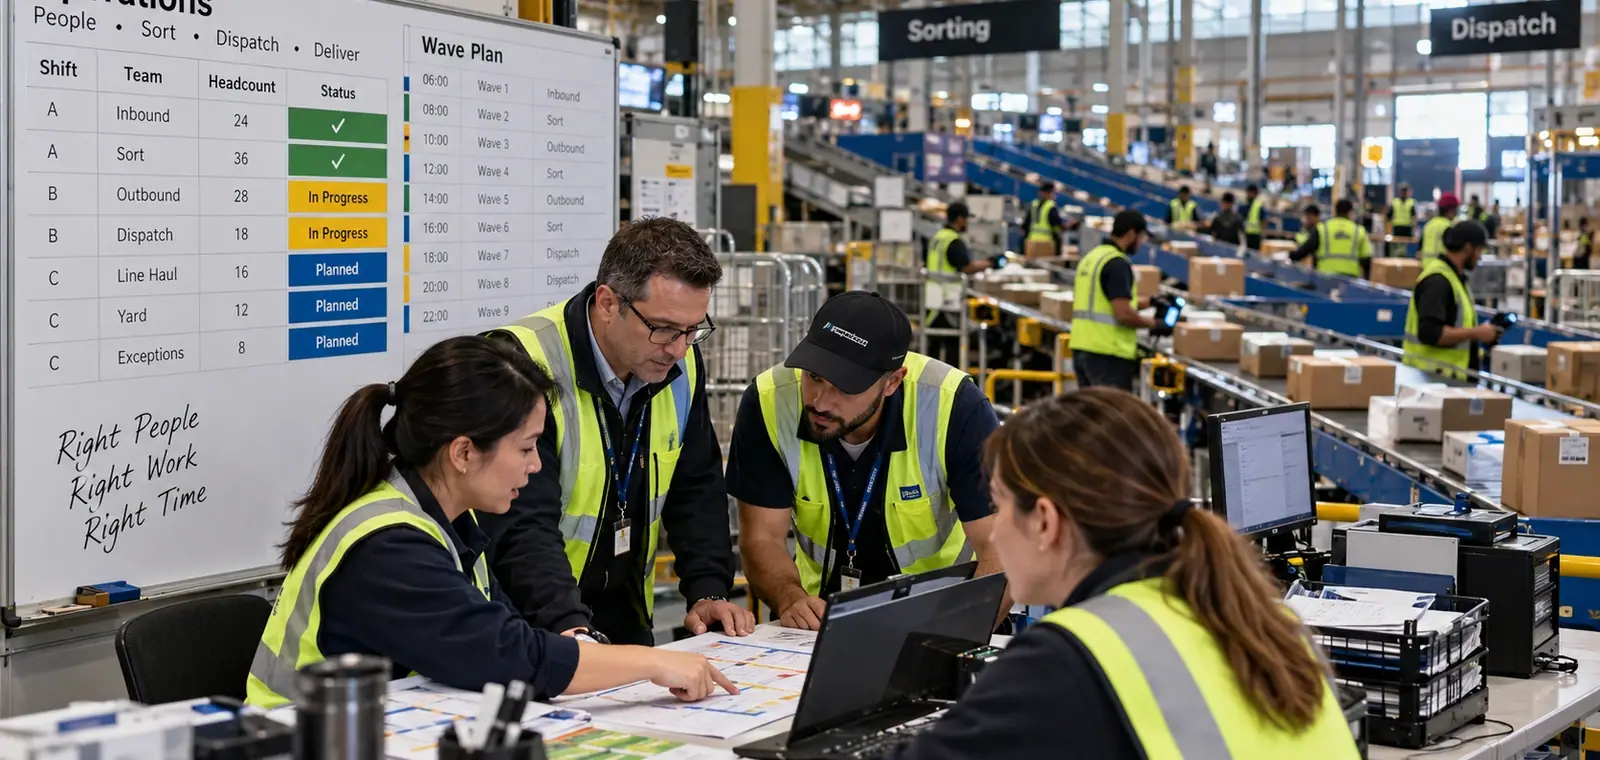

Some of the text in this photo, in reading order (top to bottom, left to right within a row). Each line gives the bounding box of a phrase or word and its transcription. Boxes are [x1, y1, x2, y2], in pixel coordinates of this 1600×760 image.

[35, 6, 96, 32] People
[142, 20, 175, 40] Sort
[217, 30, 278, 52] Dispatch
[315, 42, 359, 61] Deliver
[908, 16, 990, 43] Sorting
[1451, 12, 1557, 43] Dispatch
[422, 36, 502, 63] Wave Plan
[40, 60, 77, 77] Shift
[124, 67, 162, 83] Team
[209, 74, 275, 93] Headcount
[423, 74, 448, 87] 06:00
[478, 80, 508, 93] Wave 1
[321, 85, 355, 99] Status
[546, 89, 580, 102] Inbound
[48, 102, 58, 116] A
[117, 106, 169, 122] Inbound
[423, 104, 448, 116] 08:00
[478, 109, 509, 122] Wave 2
[234, 114, 248, 127] 24
[547, 115, 563, 126] Sort
[424, 134, 448, 145] 10:00
[478, 137, 509, 149] Wave 3
[48, 144, 57, 158] A
[117, 147, 144, 161] Sort
[547, 141, 584, 154] Outbound
[235, 152, 248, 165] 36
[424, 163, 448, 175] 12:00
[478, 166, 508, 176] Wave 4
[547, 168, 563, 179] Sort
[49, 186, 57, 200] B
[117, 187, 180, 201] Outbound
[235, 190, 248, 202] 28
[309, 191, 368, 206] In Progress
[424, 193, 448, 204] 14:00
[478, 194, 509, 204] Wave 5
[547, 195, 584, 205] Outbound
[424, 222, 448, 233] 16:00
[478, 222, 509, 232] Wave 6
[547, 221, 563, 232] Sort
[49, 228, 57, 243] B
[118, 228, 173, 245] Dispatch
[235, 227, 248, 240] 18
[309, 227, 368, 242] In Progress
[424, 252, 448, 263] 18:00
[478, 250, 508, 261] Wave 7
[547, 248, 579, 260] Dispatch
[118, 267, 177, 282] Line Haul
[235, 265, 248, 278] 16
[317, 262, 358, 276] Planned
[49, 271, 58, 285] C
[478, 277, 509, 289] Wave 8
[547, 275, 579, 287] Dispatch
[423, 281, 448, 293] 20:00
[236, 303, 248, 316] 12
[316, 297, 358, 312] Planned
[478, 305, 509, 317] Wave 9
[50, 313, 59, 328] C
[118, 308, 146, 323] Yard
[423, 310, 448, 322] 22:00
[317, 333, 358, 348] Planned
[239, 341, 245, 354] 8
[119, 347, 184, 365] Exceptions
[50, 356, 59, 370] C
[57, 404, 199, 472] Right People
[69, 443, 198, 513] Right Work
[84, 486, 207, 553] Right Time
